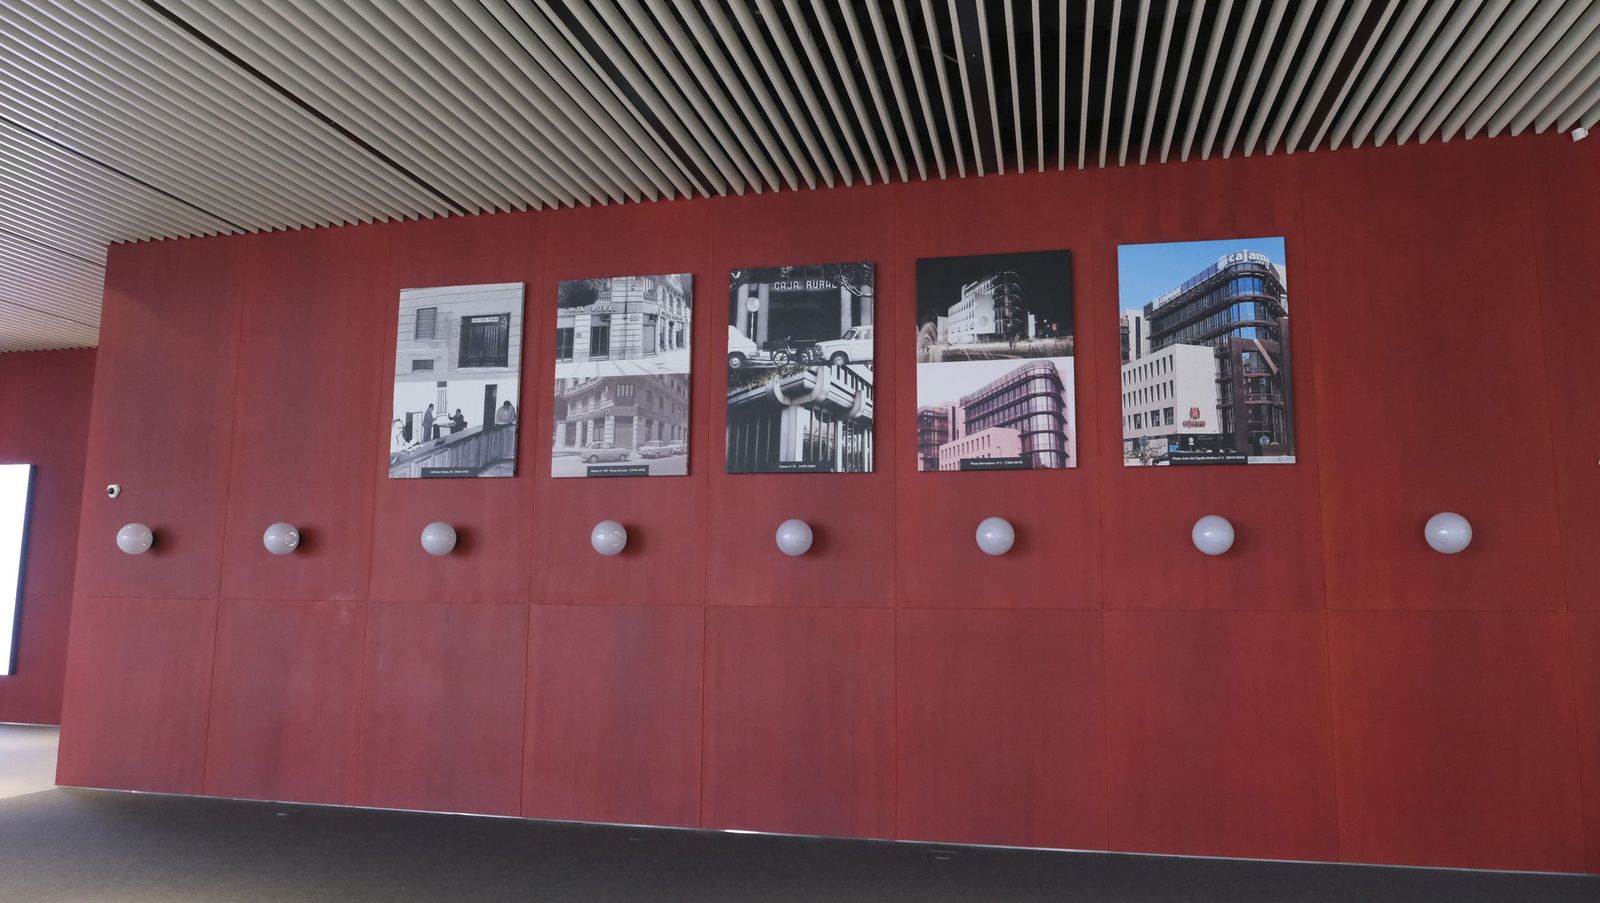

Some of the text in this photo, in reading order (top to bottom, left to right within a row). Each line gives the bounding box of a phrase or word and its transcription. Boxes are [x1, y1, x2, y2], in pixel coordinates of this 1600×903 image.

[774, 280, 837, 290] CAJA RURAL
[591, 305, 617, 313] RURAL
